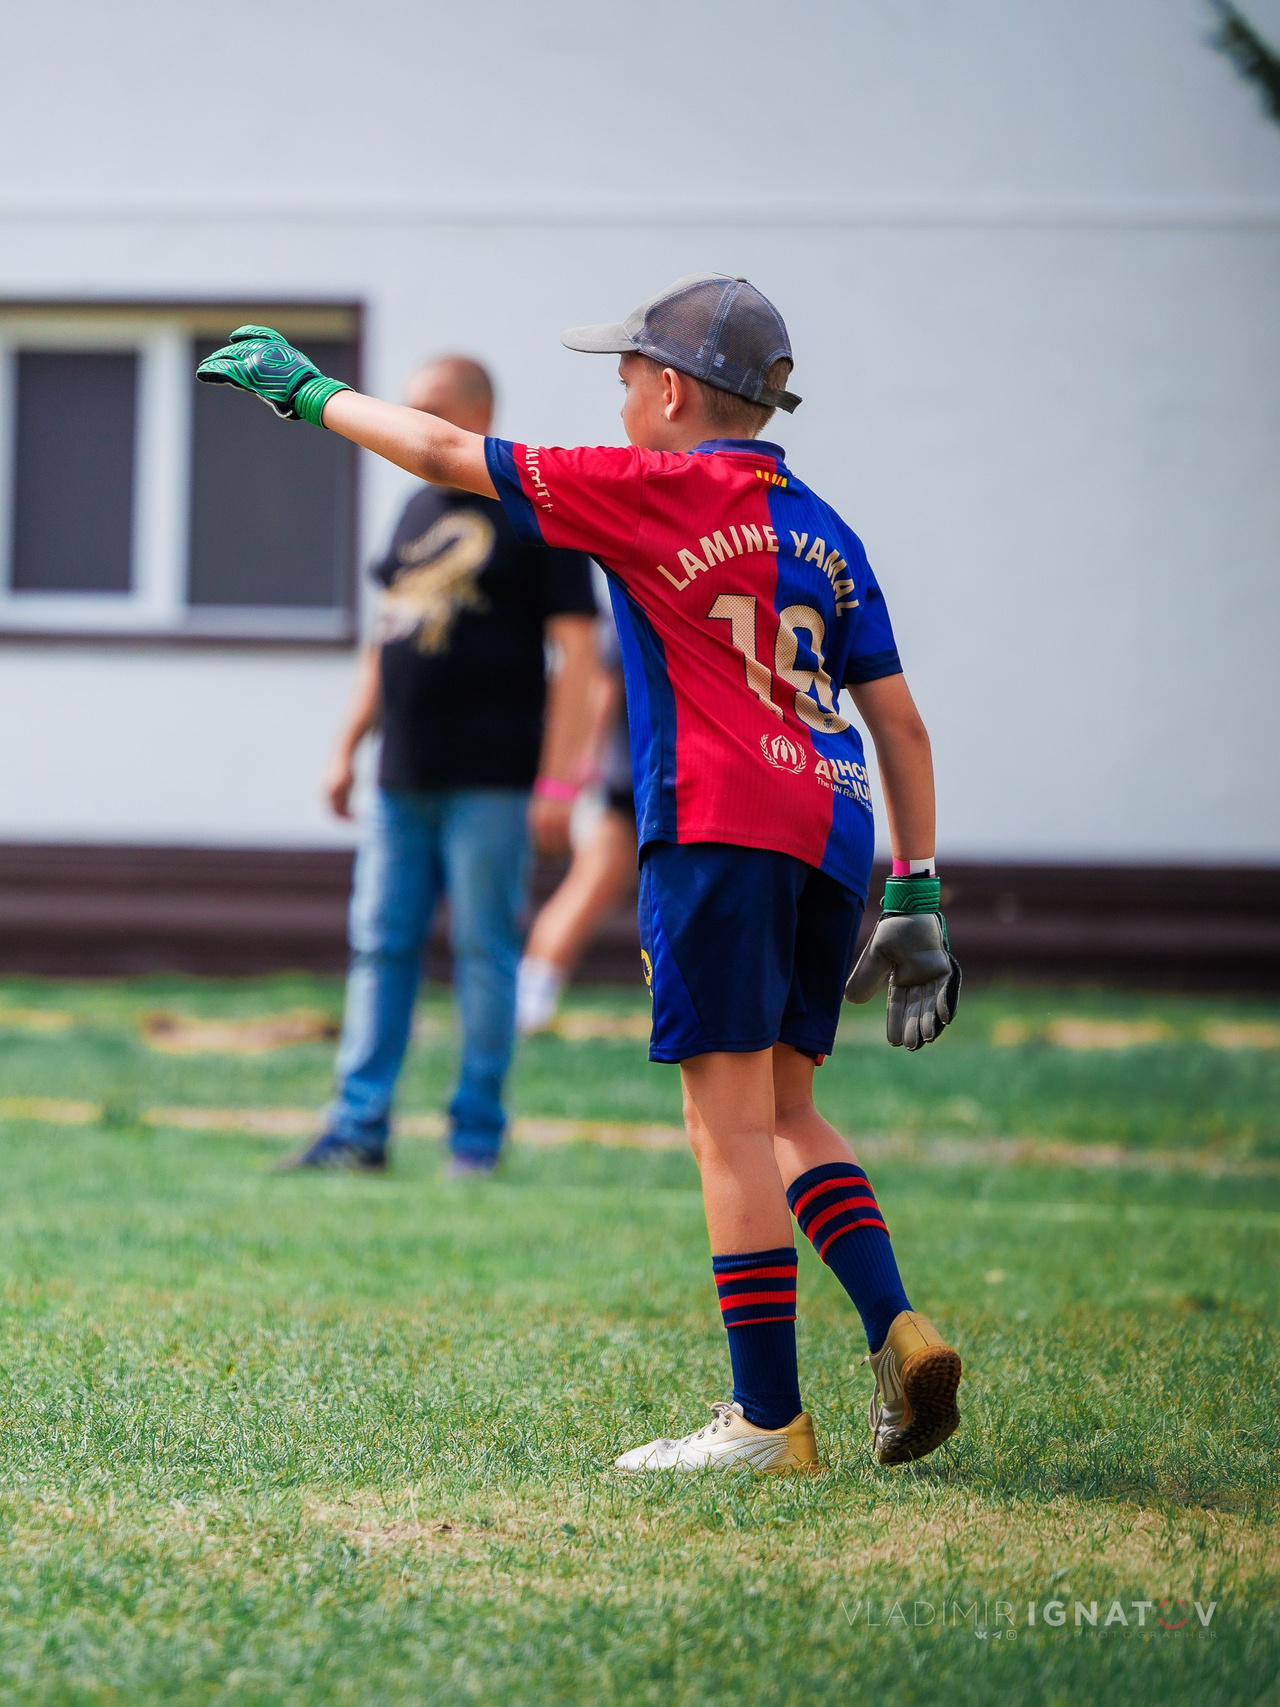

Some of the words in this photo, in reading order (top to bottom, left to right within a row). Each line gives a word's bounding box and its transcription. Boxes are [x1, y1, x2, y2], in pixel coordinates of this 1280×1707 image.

[657, 523, 779, 591] LAMINE
[789, 530, 859, 617] YAMAL
[816, 776, 830, 788] The
[830, 784, 842, 794] UN
